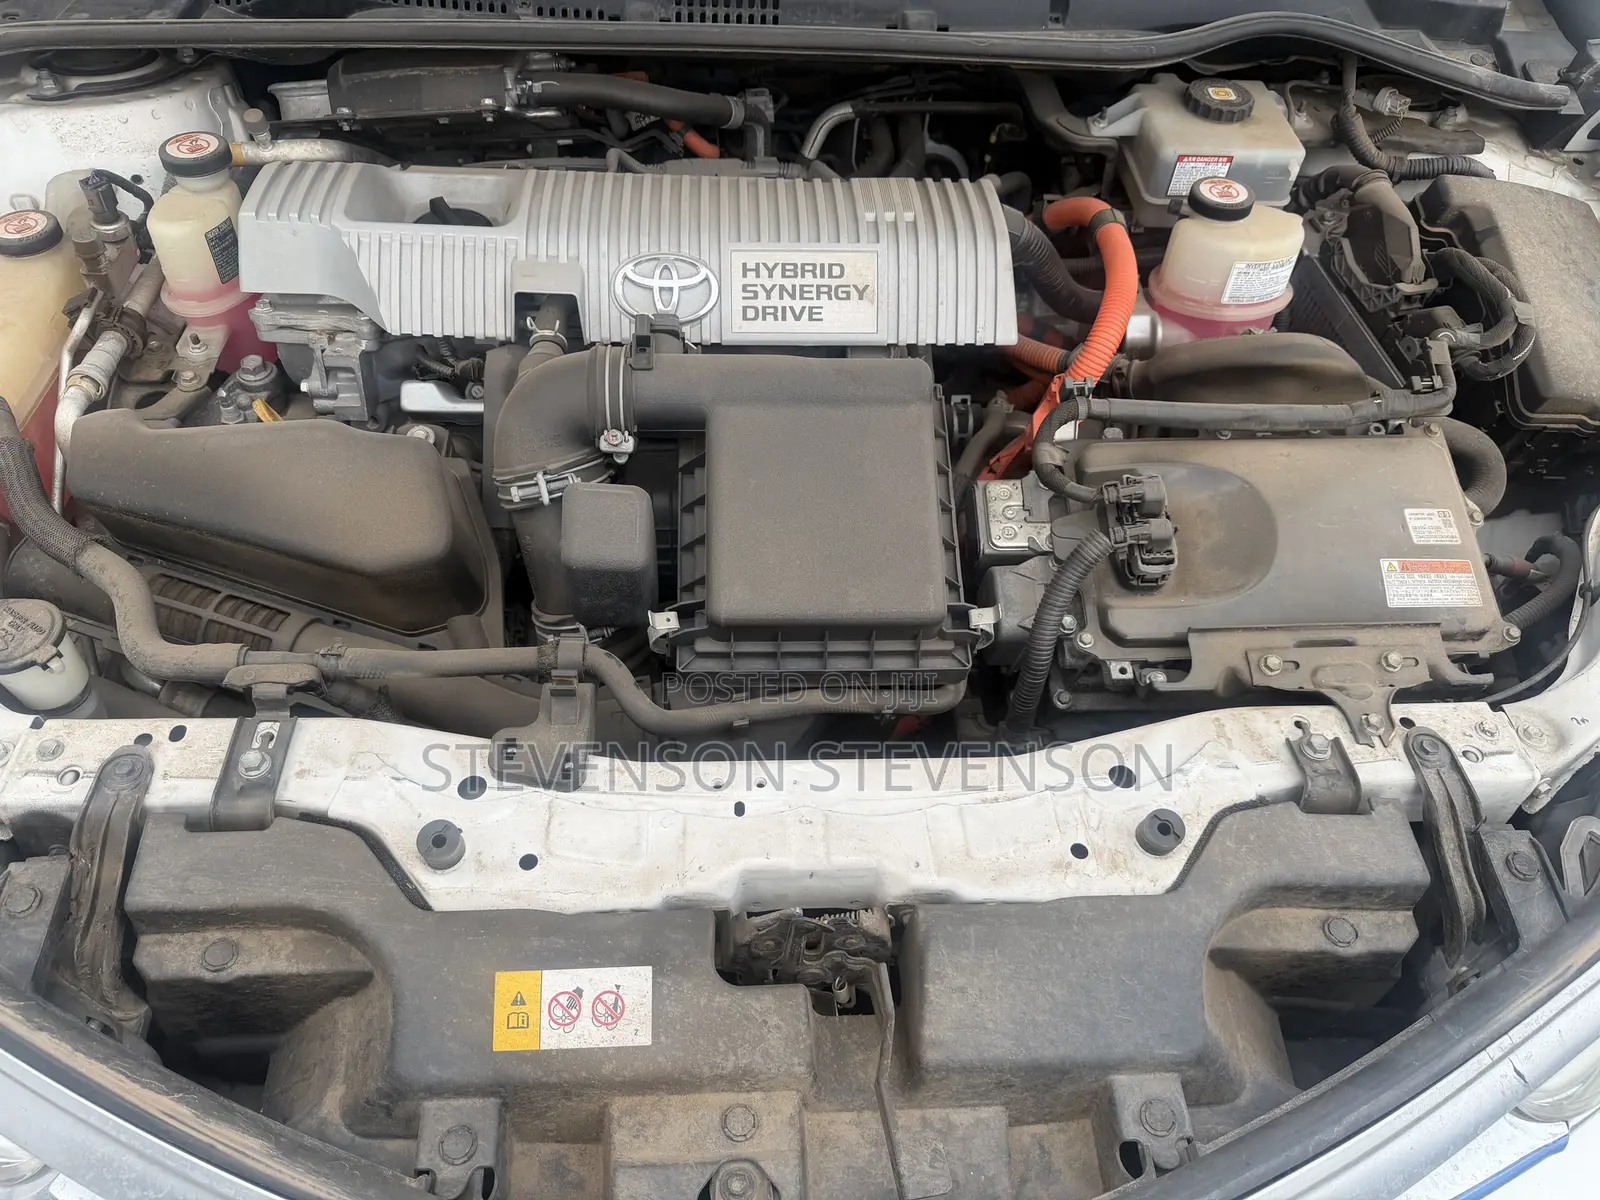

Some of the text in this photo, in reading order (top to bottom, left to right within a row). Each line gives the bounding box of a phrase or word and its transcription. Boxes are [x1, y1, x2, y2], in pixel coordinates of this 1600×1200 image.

[741, 262, 845, 279] HYBRID
[741, 284, 870, 301] SYNERGY
[741, 305, 824, 322] DRIVE
